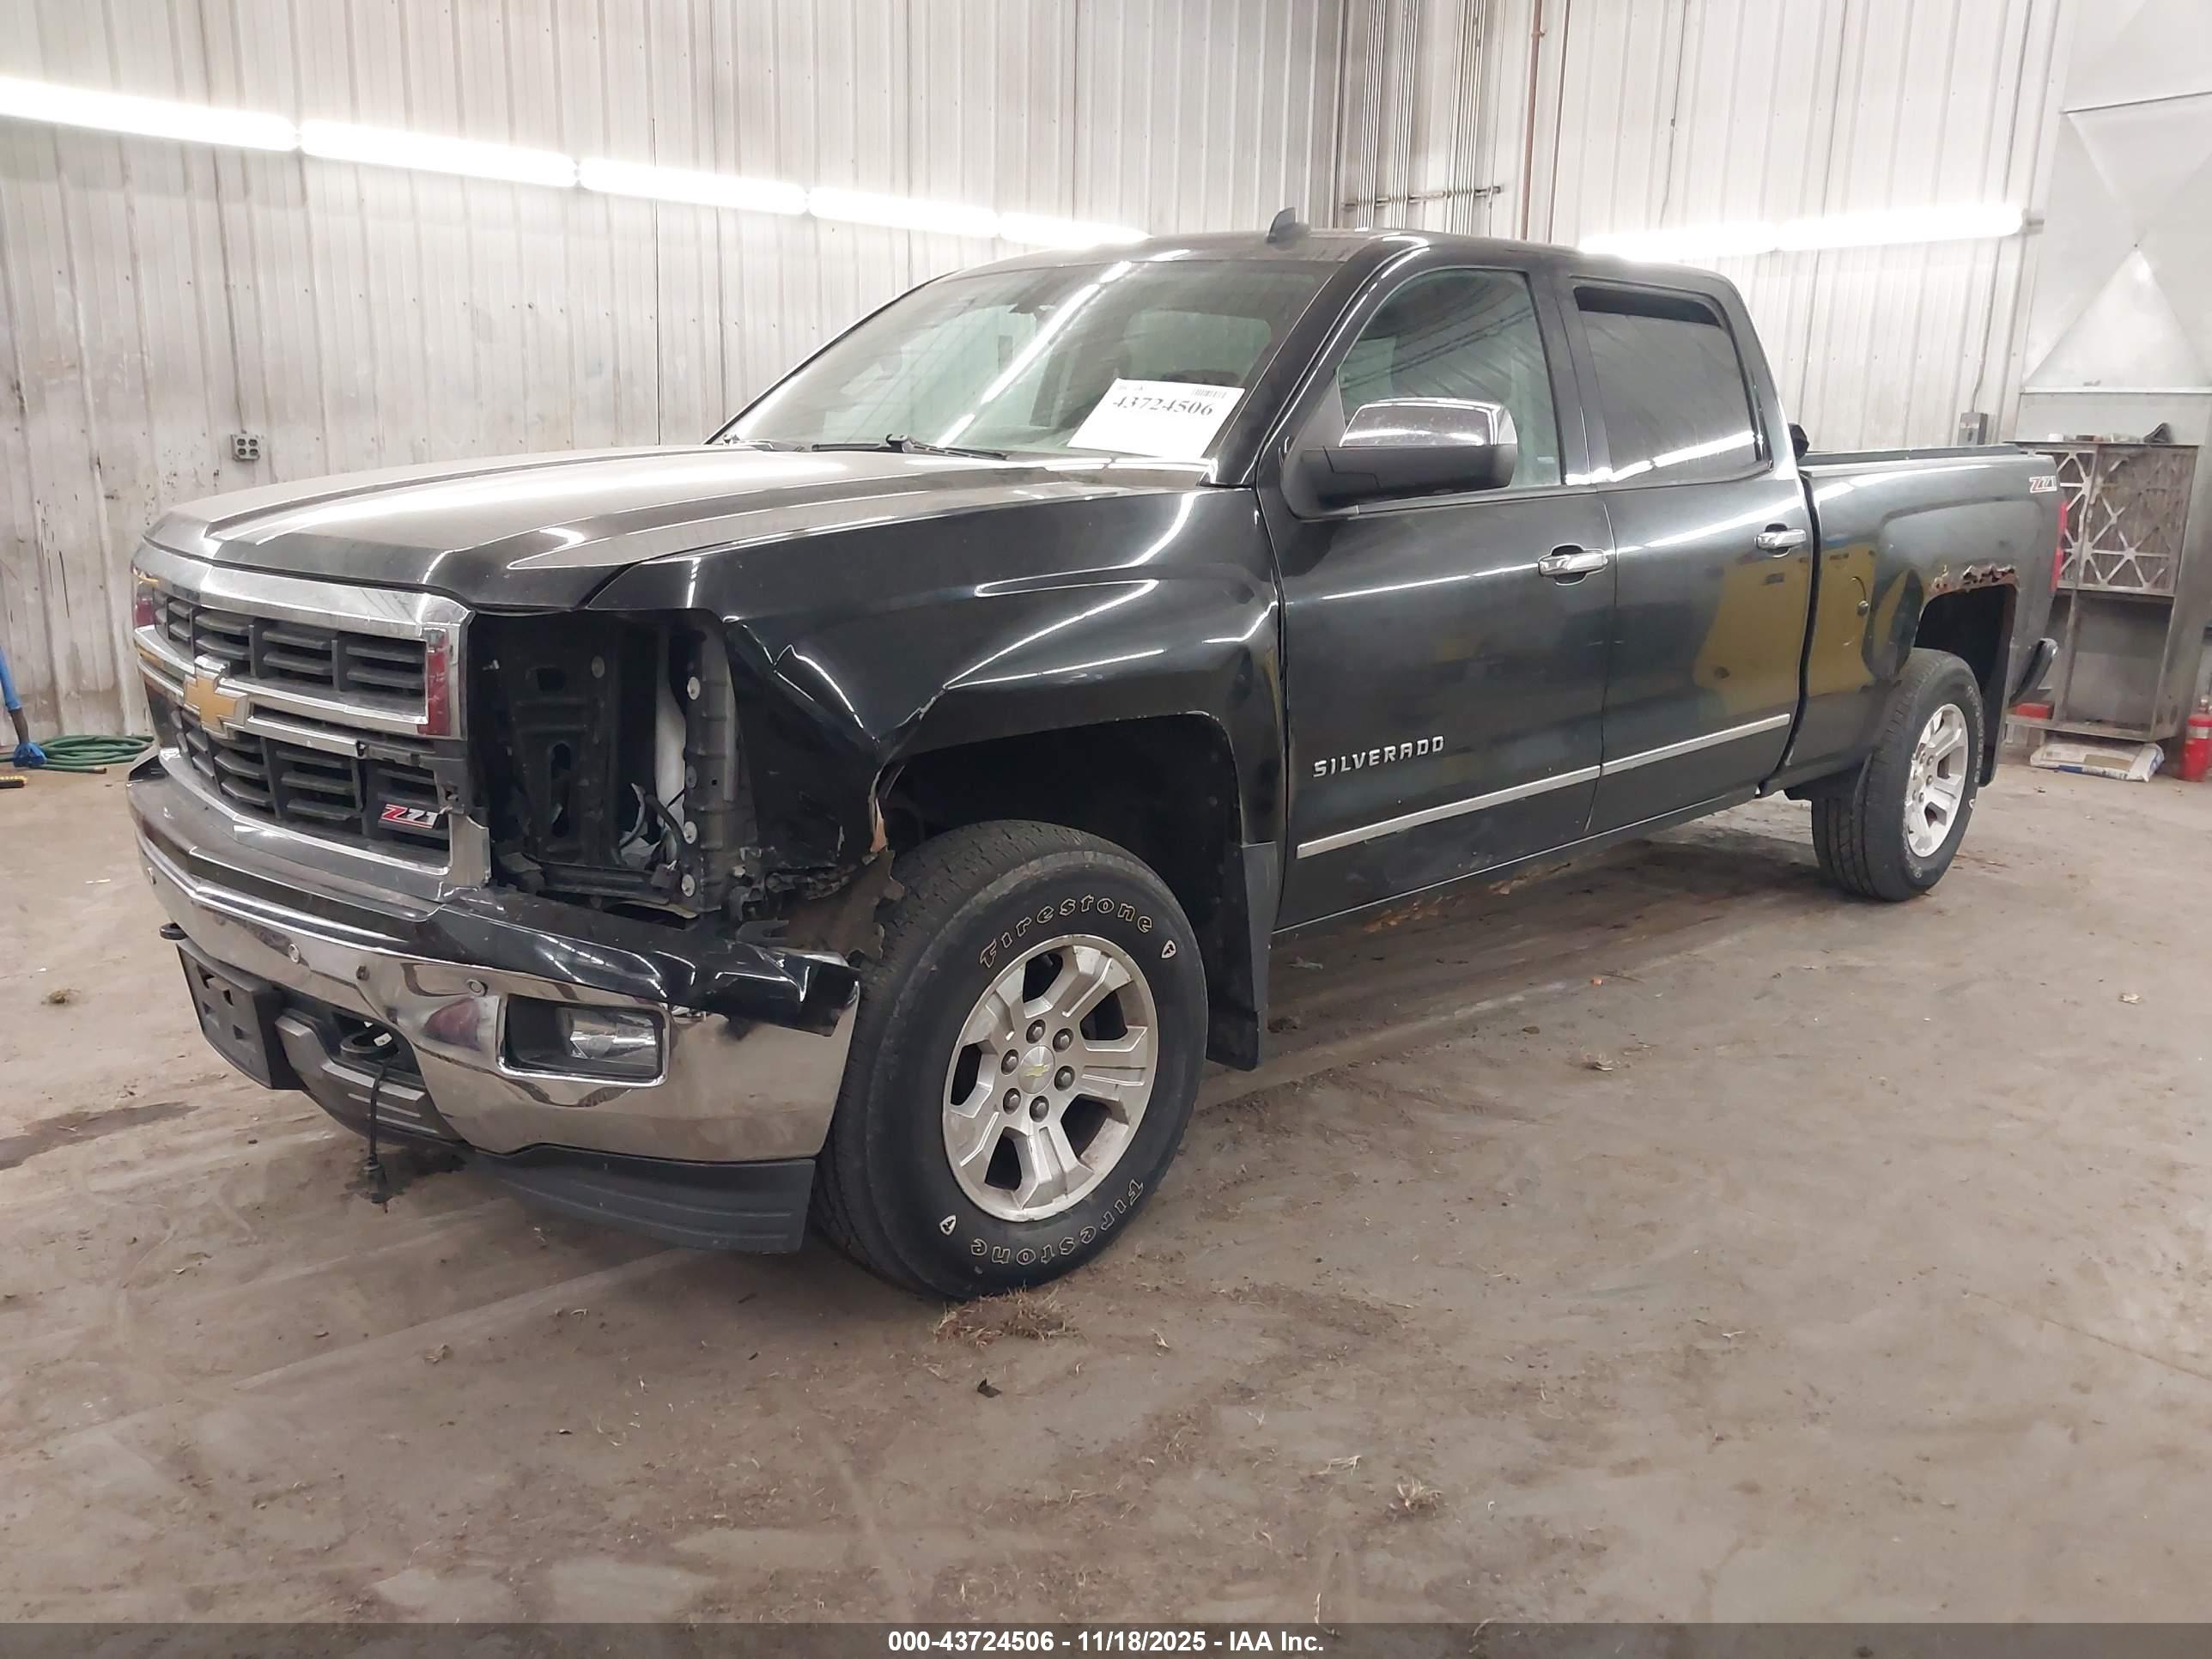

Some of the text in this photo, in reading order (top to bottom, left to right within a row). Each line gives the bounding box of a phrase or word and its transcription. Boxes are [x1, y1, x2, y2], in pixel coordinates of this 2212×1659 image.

[1113, 396, 1213, 416] 43724506
[1313, 735, 1444, 777] SILVERADO
[380, 803, 440, 829] Z71
[980, 894, 1152, 968] Firestone
[970, 1178, 1144, 1265] Firestone
